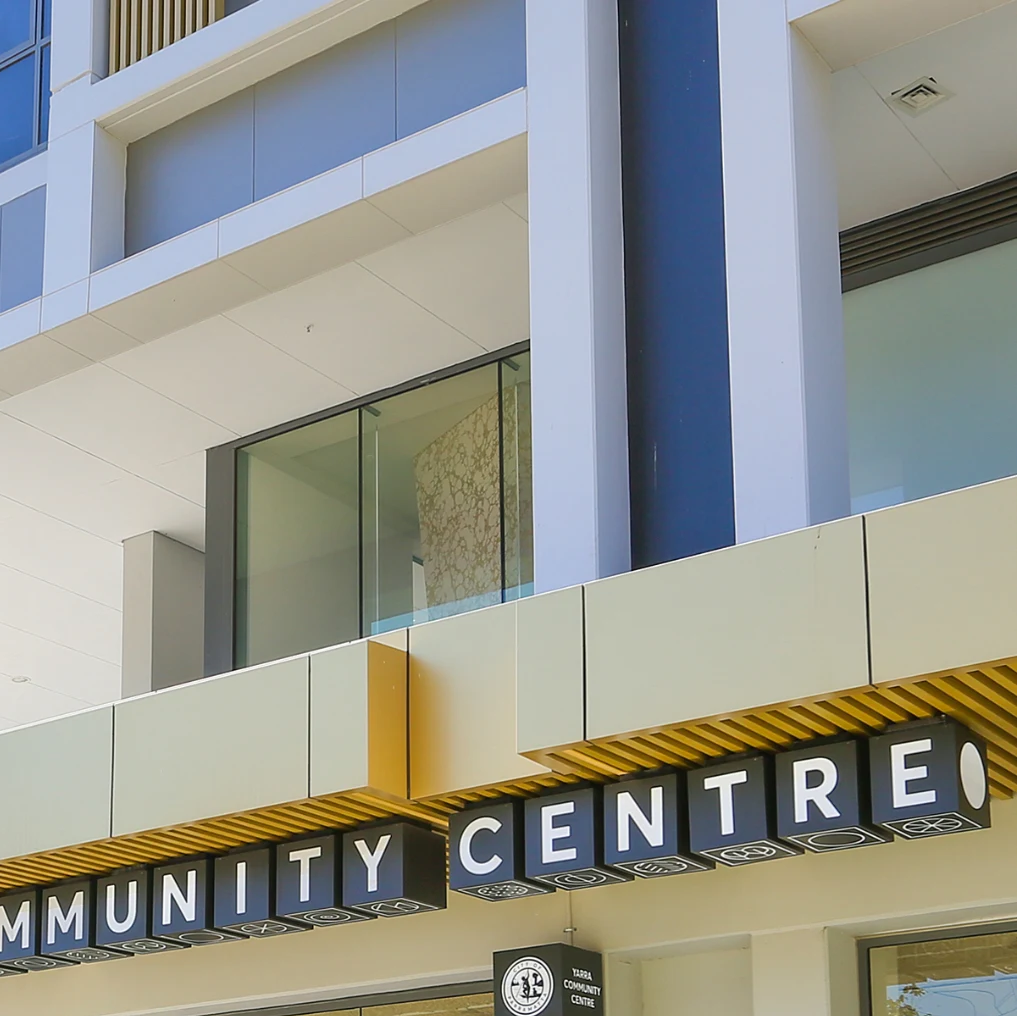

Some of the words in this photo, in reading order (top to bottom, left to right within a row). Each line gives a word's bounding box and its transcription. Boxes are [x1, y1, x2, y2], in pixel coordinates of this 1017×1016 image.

[458, 738, 937, 875] CENTRE
[572, 968, 593, 981] YARRA
[564, 979, 601, 996] COMMUNITY
[571, 994, 595, 1008] CENTRE
